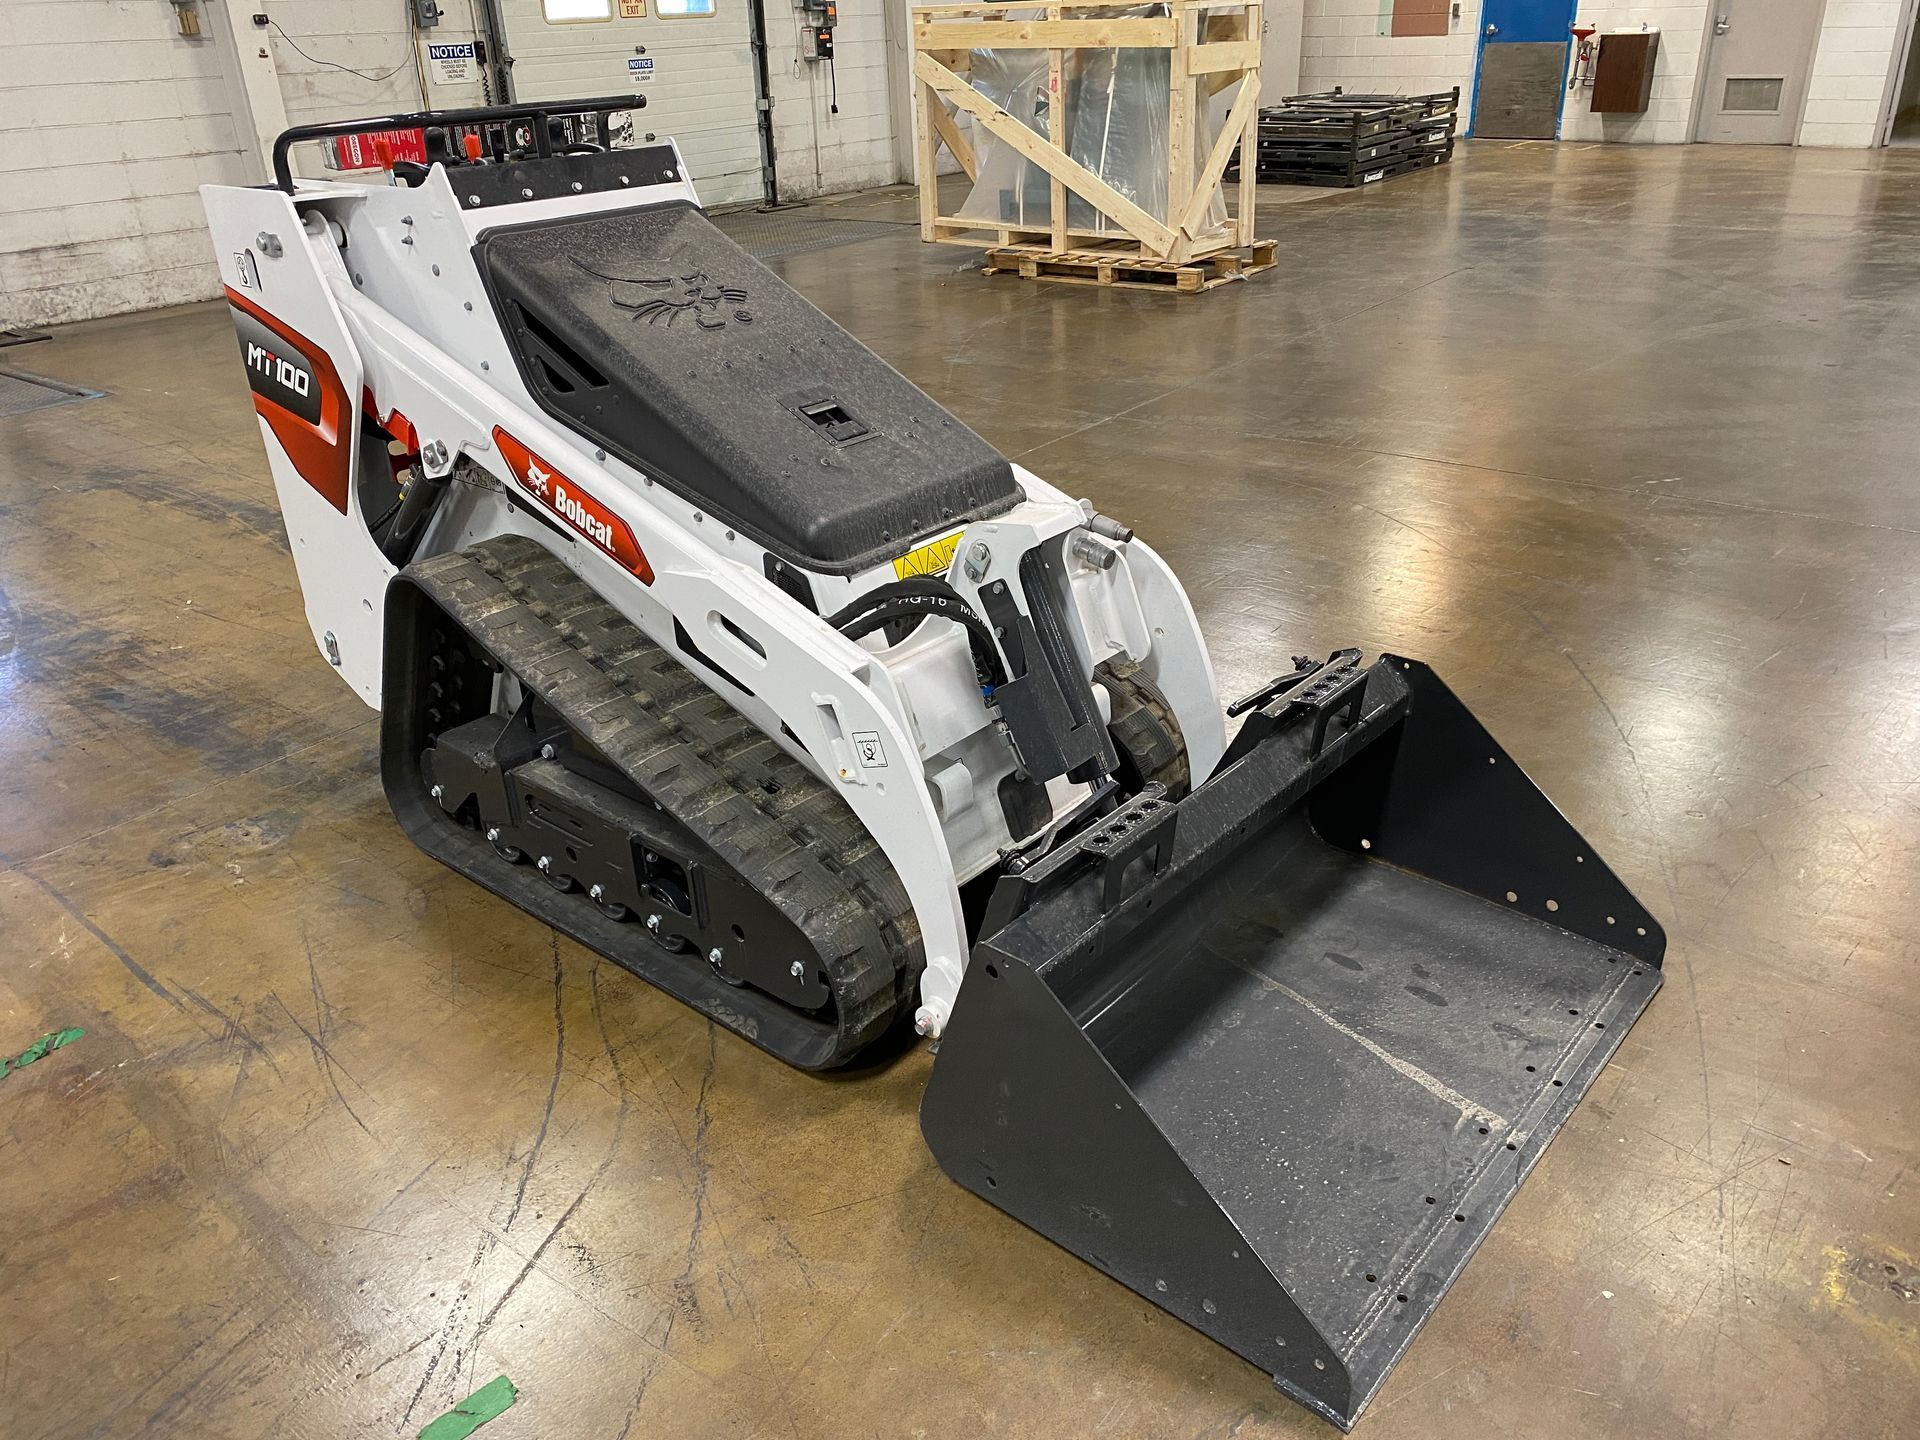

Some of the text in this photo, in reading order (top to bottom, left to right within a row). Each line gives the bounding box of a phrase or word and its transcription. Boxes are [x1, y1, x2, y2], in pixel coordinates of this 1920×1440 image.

[626, 5, 639, 15] EXIT
[431, 46, 472, 58] NOTICE
[629, 59, 652, 68] NOTICE
[351, 136, 361, 164] OREGON
[247, 341, 309, 398] MT100
[555, 484, 613, 550] Bobcat
